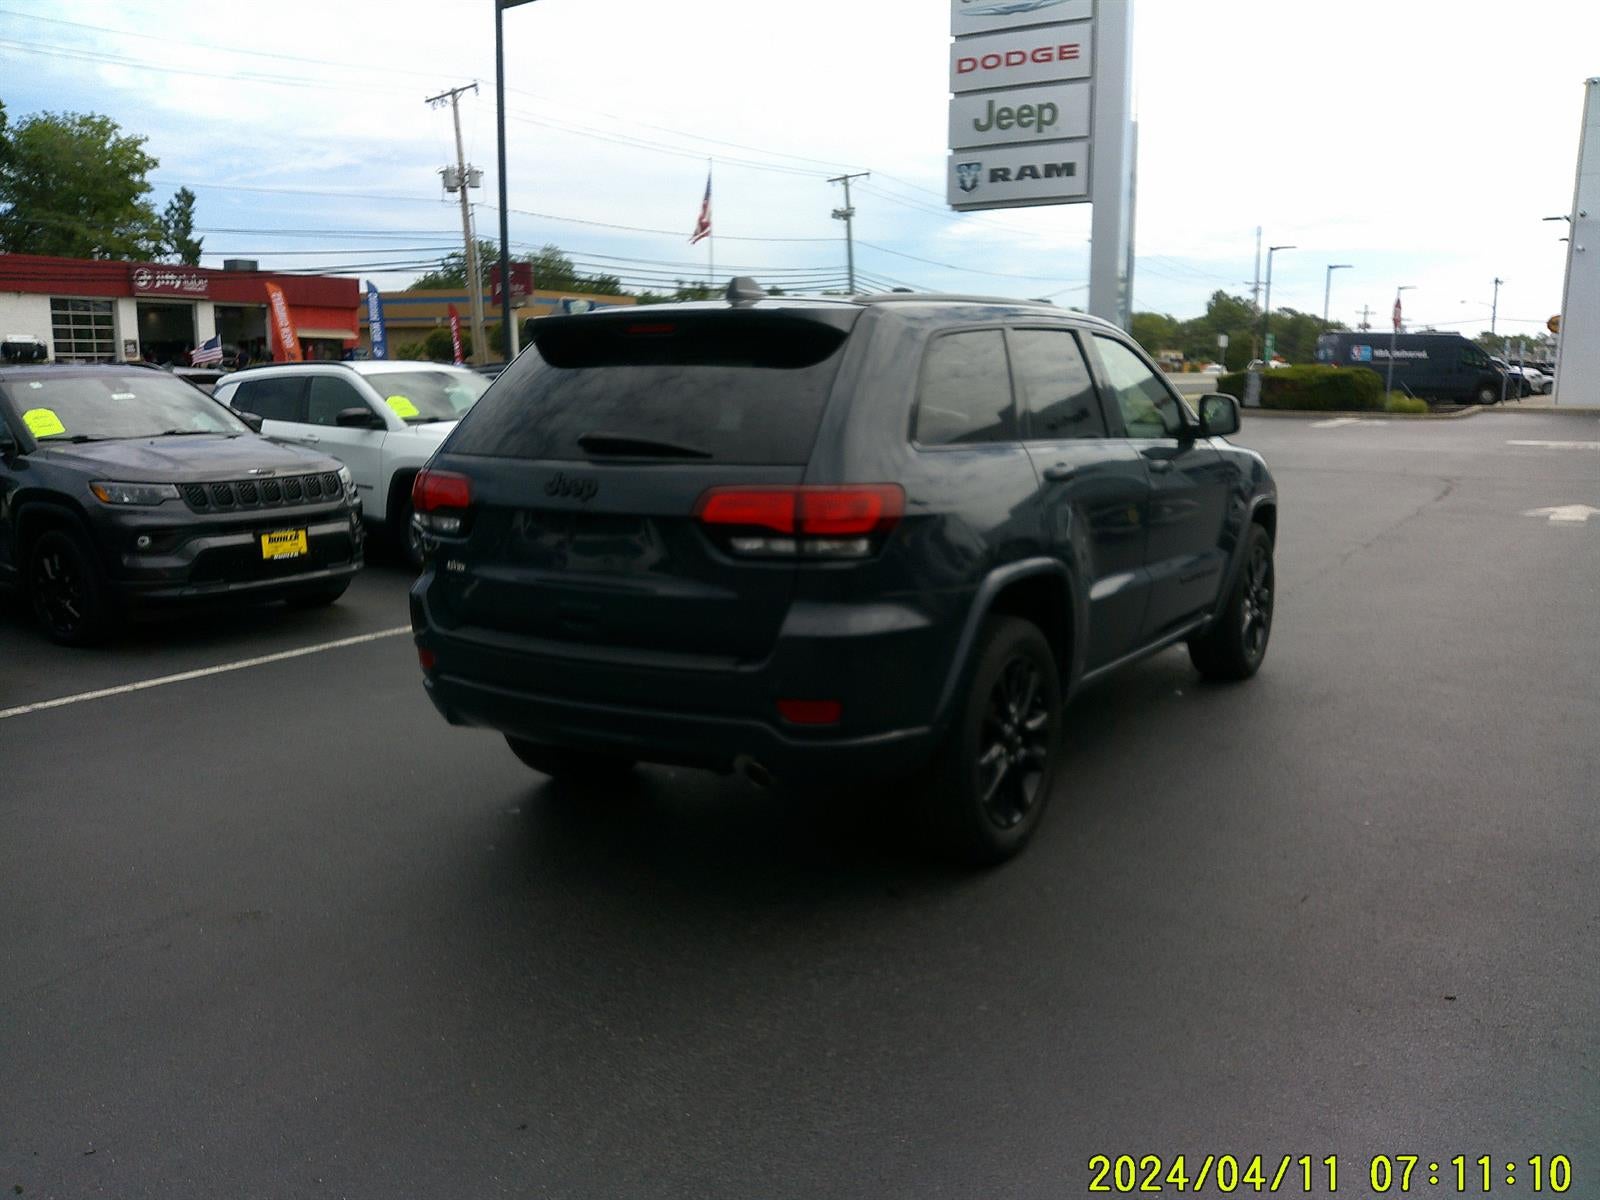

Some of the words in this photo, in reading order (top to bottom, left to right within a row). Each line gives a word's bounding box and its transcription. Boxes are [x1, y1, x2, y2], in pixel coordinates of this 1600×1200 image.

[957, 43, 1081, 74] DODGE
[973, 99, 1059, 134] Jeep
[988, 161, 1077, 184] RAM
[544, 471, 599, 503] Jeep
